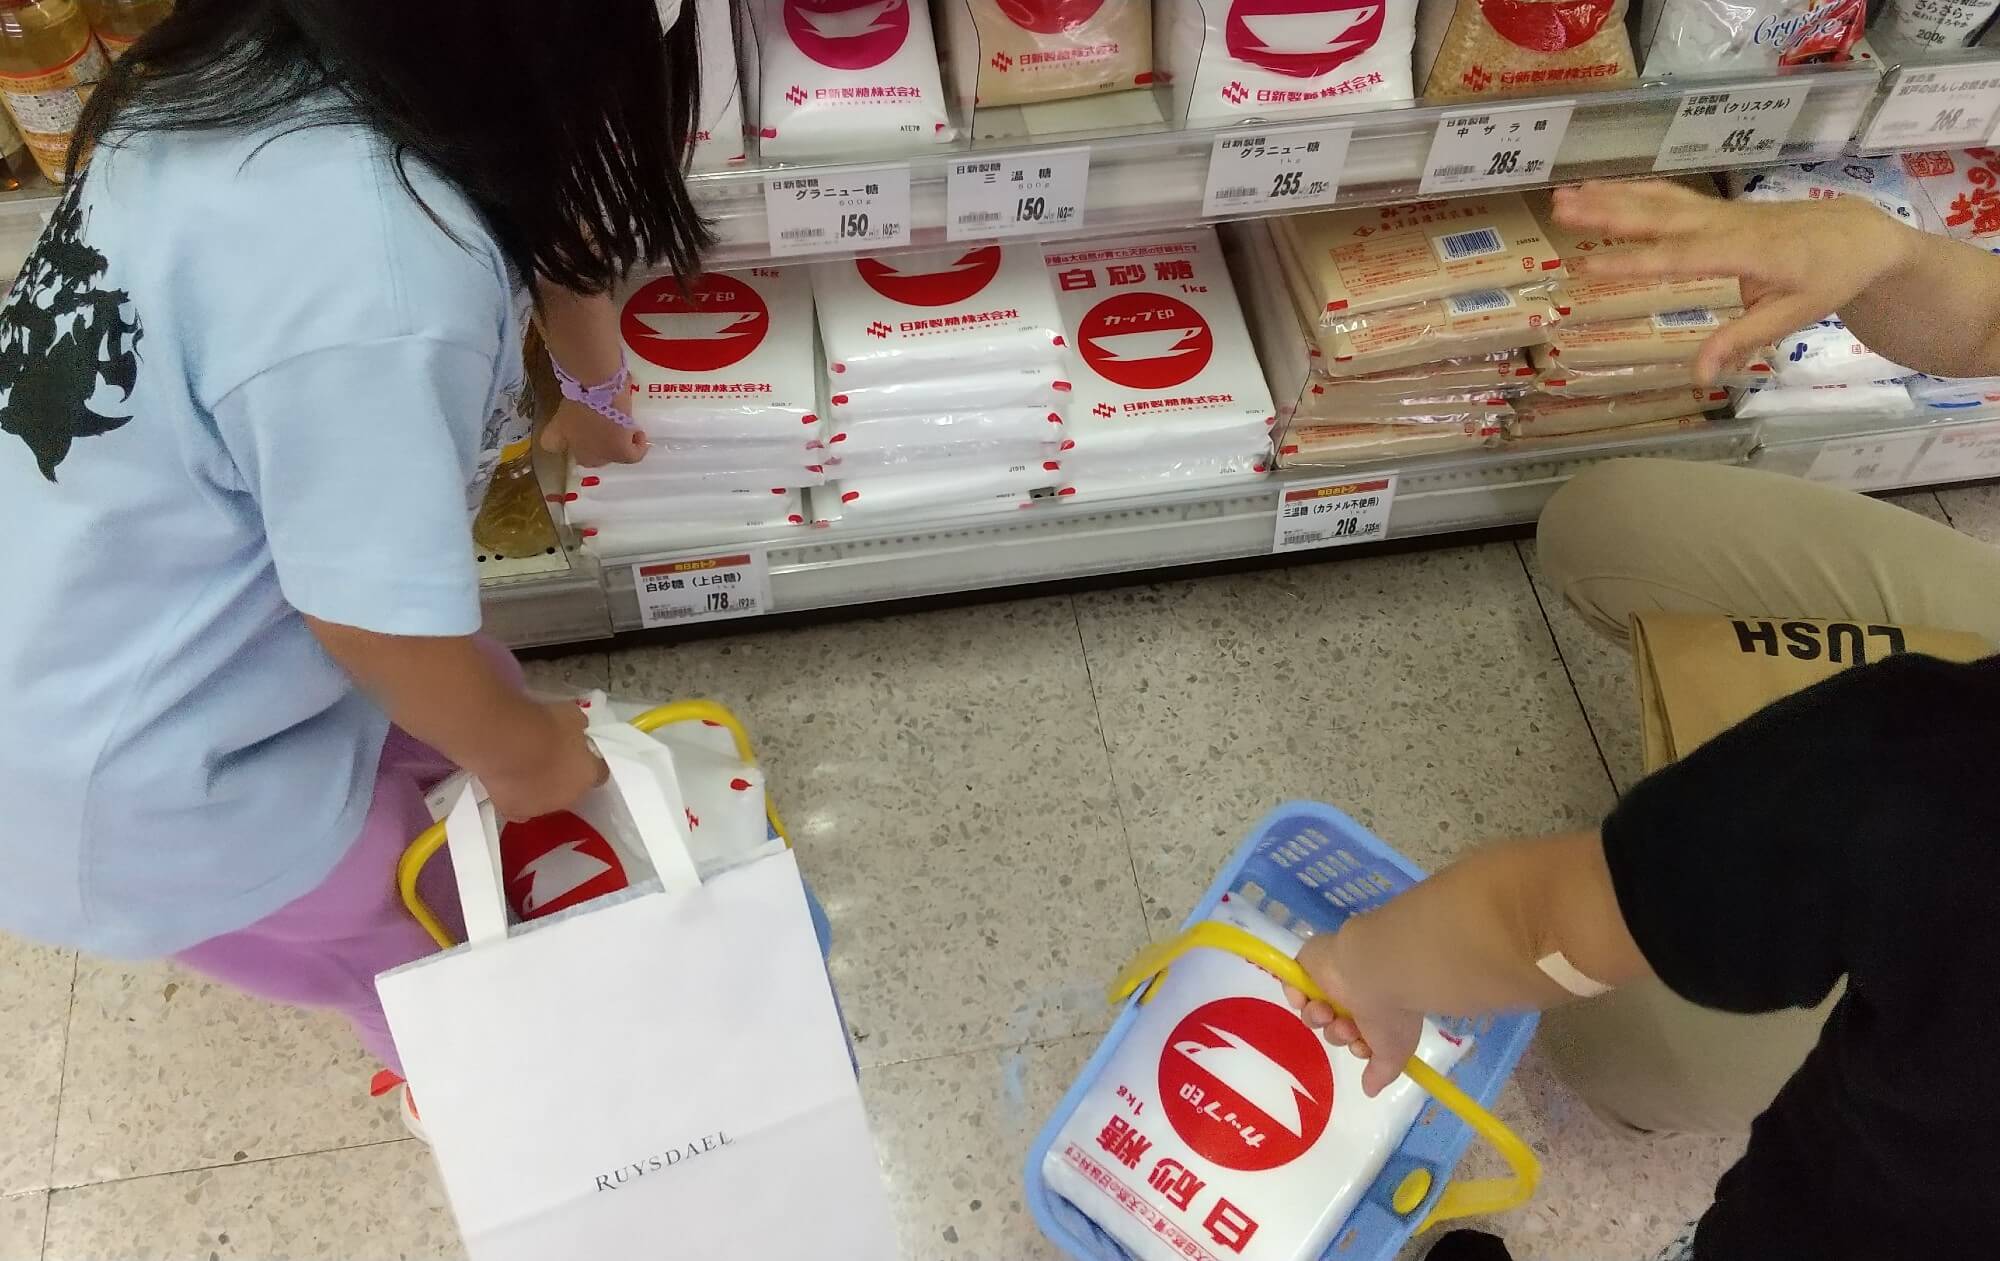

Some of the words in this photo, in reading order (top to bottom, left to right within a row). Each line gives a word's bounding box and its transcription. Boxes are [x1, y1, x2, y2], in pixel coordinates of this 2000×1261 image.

[1916, 28, 1946, 44] 200g
[815, 86, 922, 99] 日新製糖株式会社
[1256, 71, 1383, 101] 日新製糖株式会社
[1240, 141, 1321, 159] グラニュー糖
[1721, 128, 1756, 153] 435
[1486, 149, 1522, 176] 285
[772, 178, 819, 191] 日新製糖
[795, 183, 879, 201] グラニュー糖
[1269, 171, 1303, 198] 255
[1016, 196, 1045, 222] 150
[840, 213, 869, 239] 150
[751, 268, 780, 279] 1kg
[1058, 260, 1194, 292] 白砂糖
[1180, 284, 1208, 294] 1kg
[900, 309, 1019, 332] 日新製糖株式会社
[1103, 308, 1175, 326] カップ印
[649, 384, 772, 393] 日新製糖株式会社
[1123, 394, 1234, 412] 日新製糖株式会社
[1335, 517, 1358, 536] 218
[706, 592, 729, 611] 178
[1733, 620, 1906, 666] LUSH
[1116, 1085, 1144, 1116] 1kg
[1179, 1082, 1266, 1148] カップ印
[595, 1131, 733, 1192] RUYSDAEL
[1096, 1114, 1259, 1255] 白砂糖
